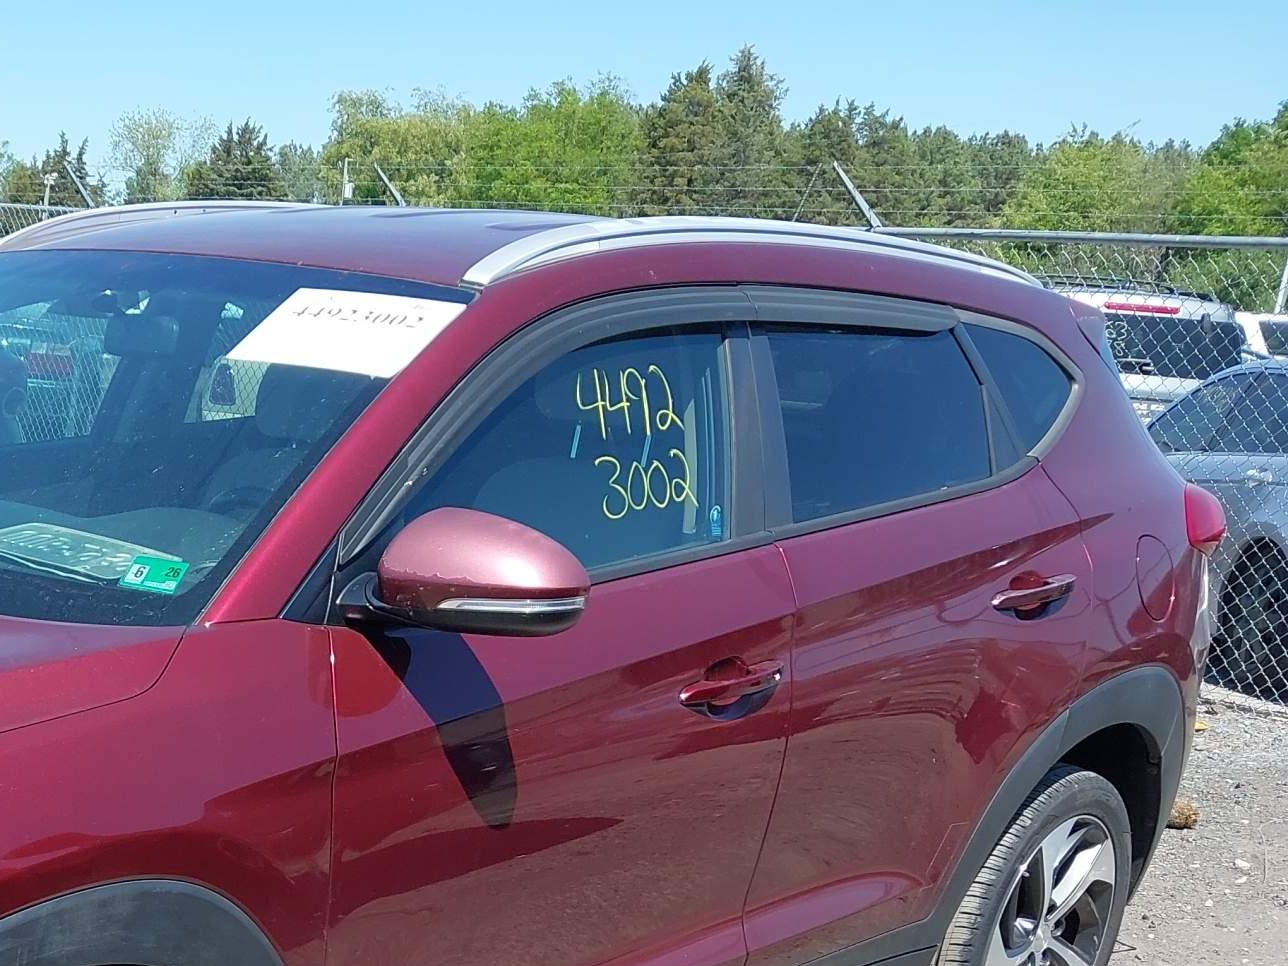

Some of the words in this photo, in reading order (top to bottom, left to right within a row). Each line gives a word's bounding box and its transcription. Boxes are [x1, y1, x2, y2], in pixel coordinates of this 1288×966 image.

[576, 364, 686, 441] 4492
[594, 448, 699, 520] 3002
[134, 566, 147, 578] 6
[165, 566, 183, 578] 26
